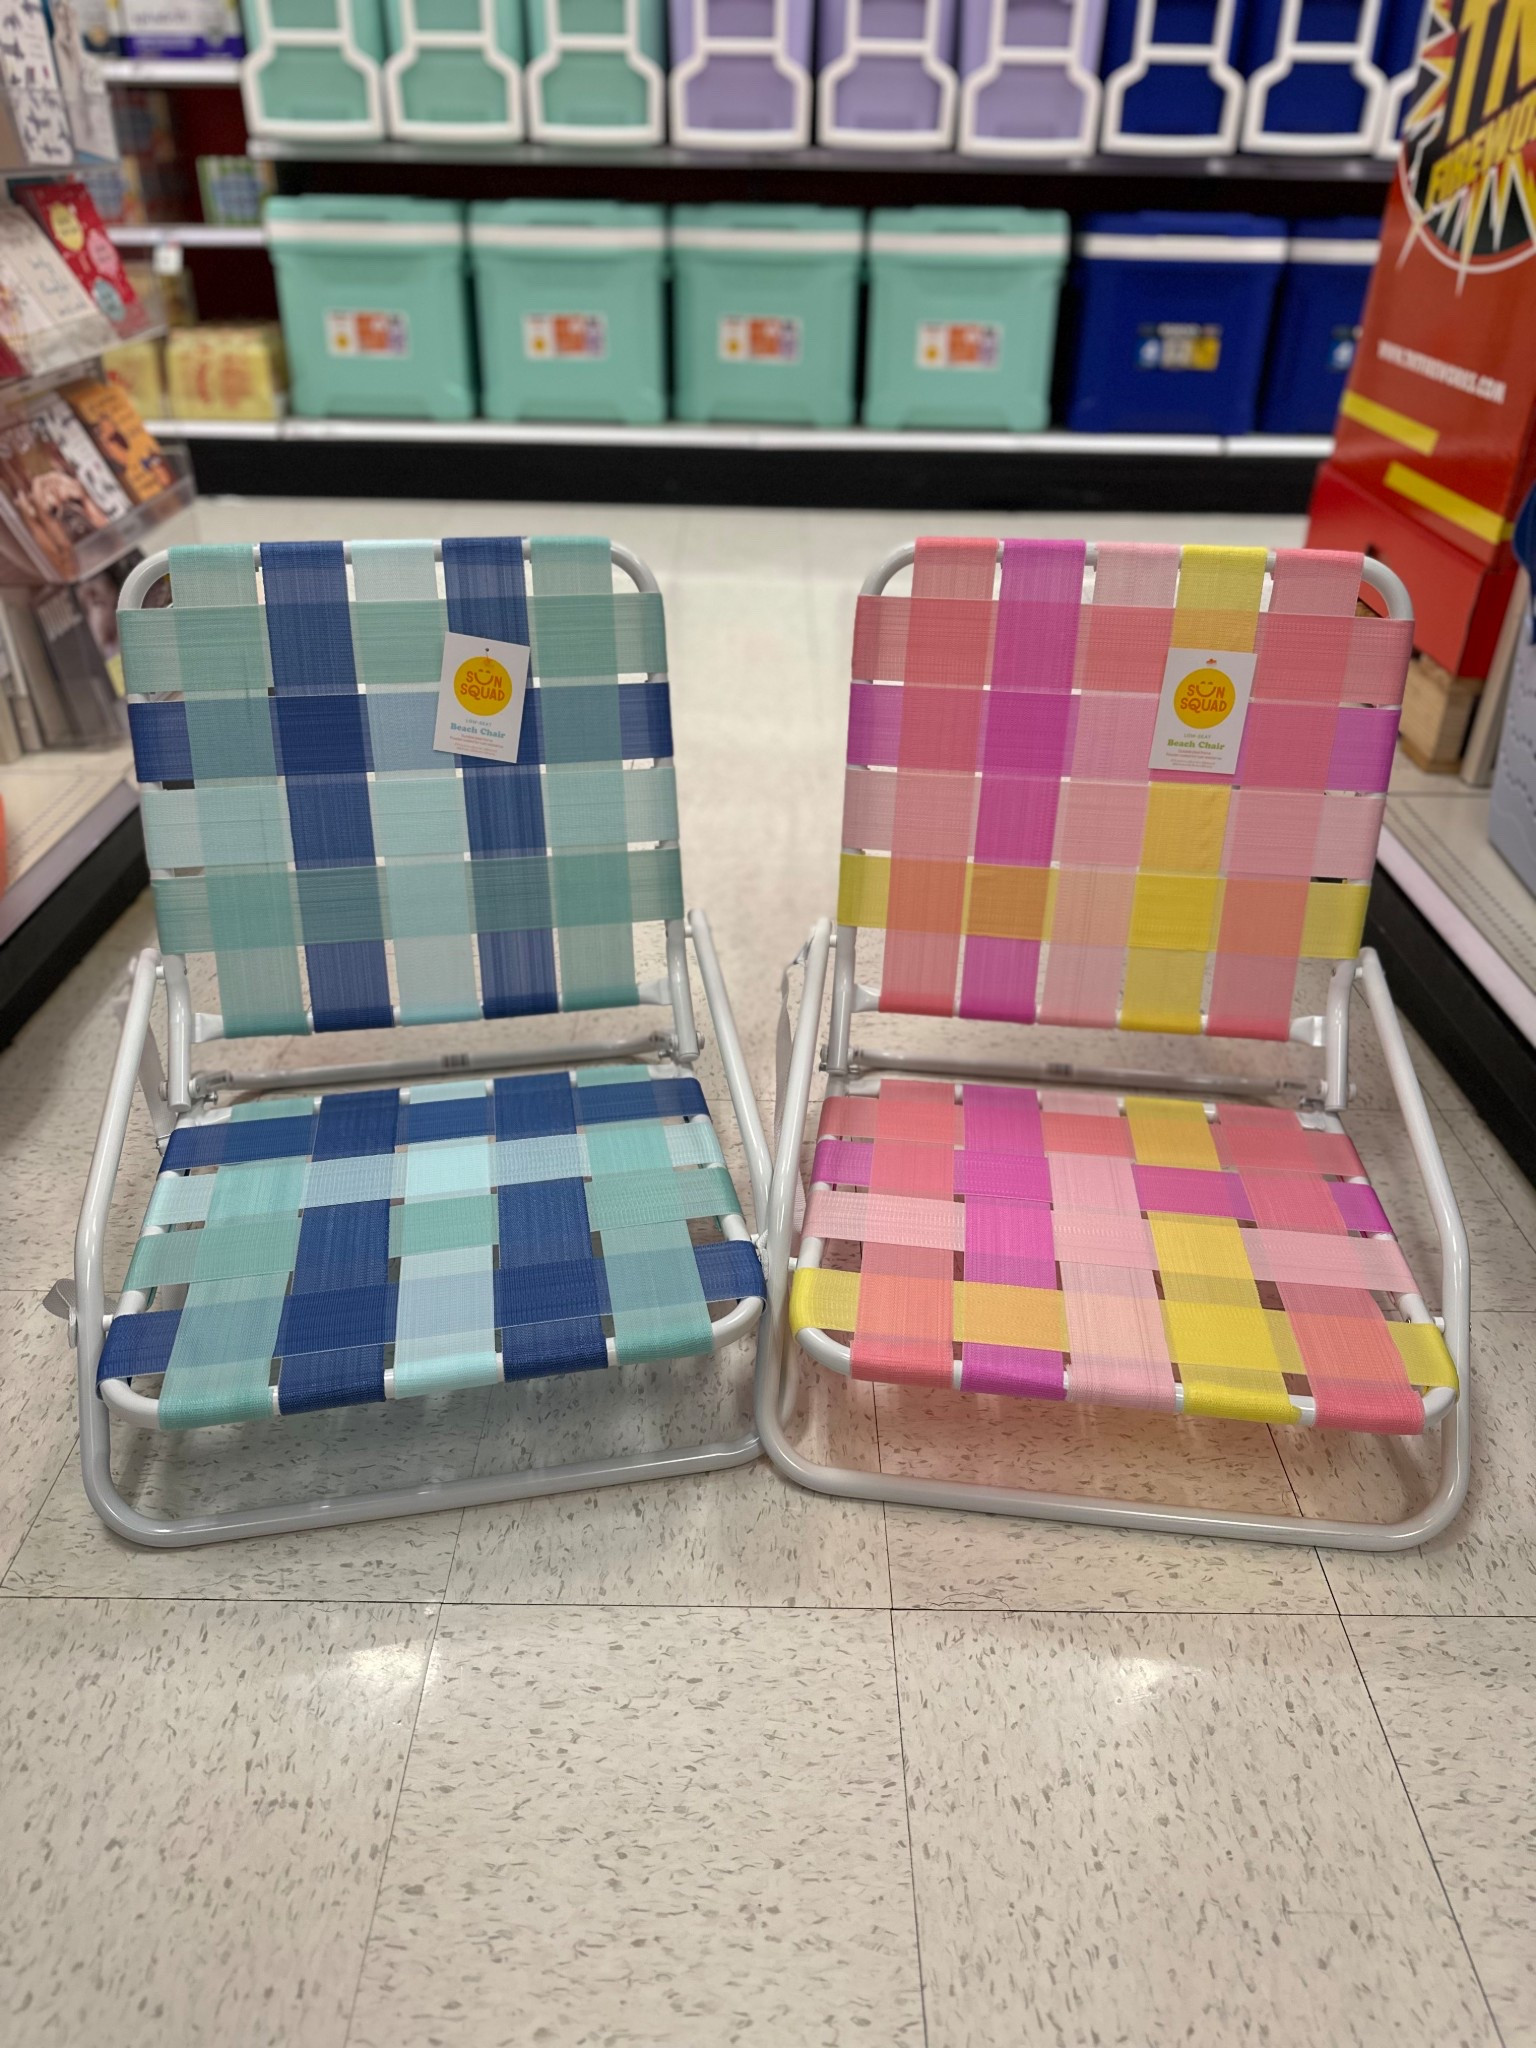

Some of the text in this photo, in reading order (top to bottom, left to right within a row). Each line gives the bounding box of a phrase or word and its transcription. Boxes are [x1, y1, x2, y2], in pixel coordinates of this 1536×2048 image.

[466, 670, 503, 689] SUN
[460, 683, 505, 701] SQUAD
[1187, 683, 1225, 699] SUN
[1180, 698, 1227, 713] SQUAD
[450, 722, 478, 734] Beach
[480, 727, 506, 739] Chair
[1167, 738, 1226, 750] Beach Chair
